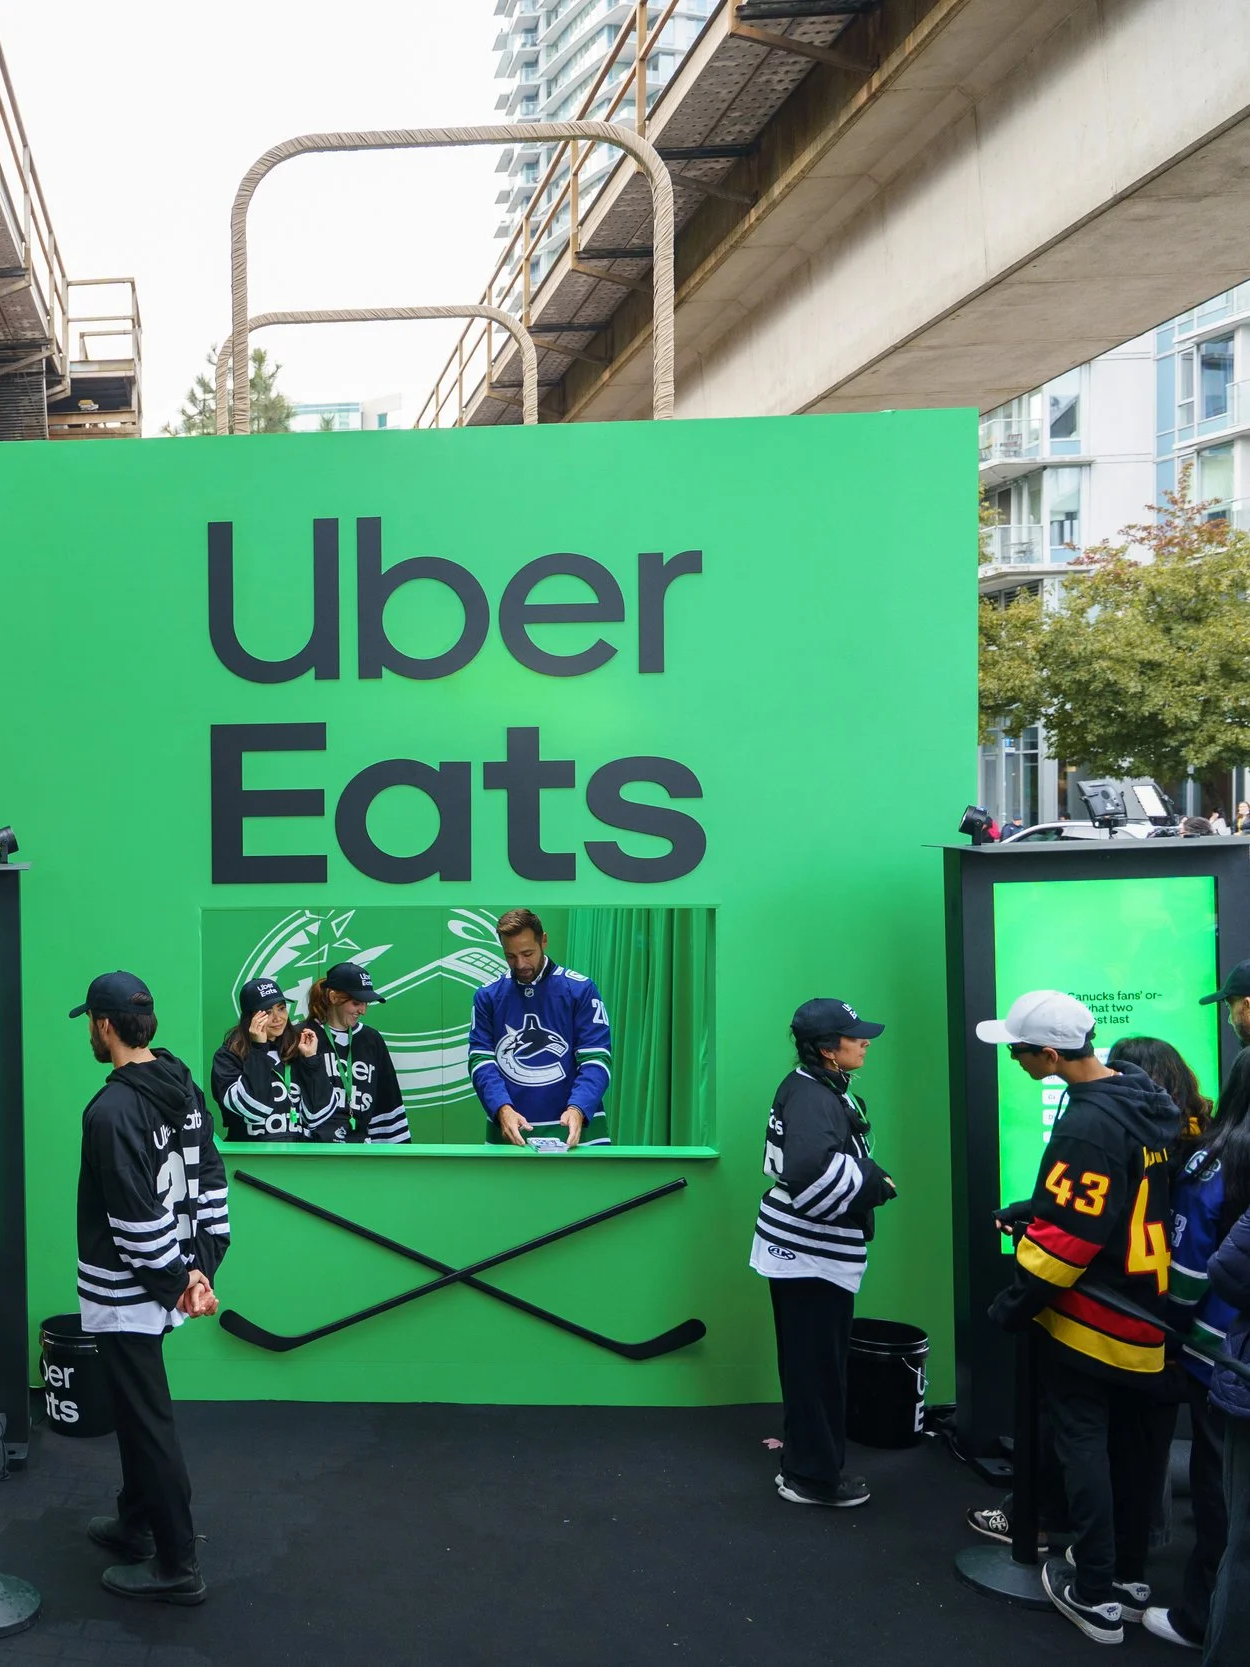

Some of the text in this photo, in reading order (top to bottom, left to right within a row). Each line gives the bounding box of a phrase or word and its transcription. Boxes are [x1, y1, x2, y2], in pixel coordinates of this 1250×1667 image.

[207, 515, 703, 685] Uber
[210, 722, 707, 884] Eats
[257, 982, 274, 992] Uber
[260, 988, 278, 998] Eats
[1145, 992, 1163, 1000] or-
[1112, 1003, 1134, 1013] two
[1110, 1014, 1130, 1024] last
[1044, 1160, 1112, 1217] 43
